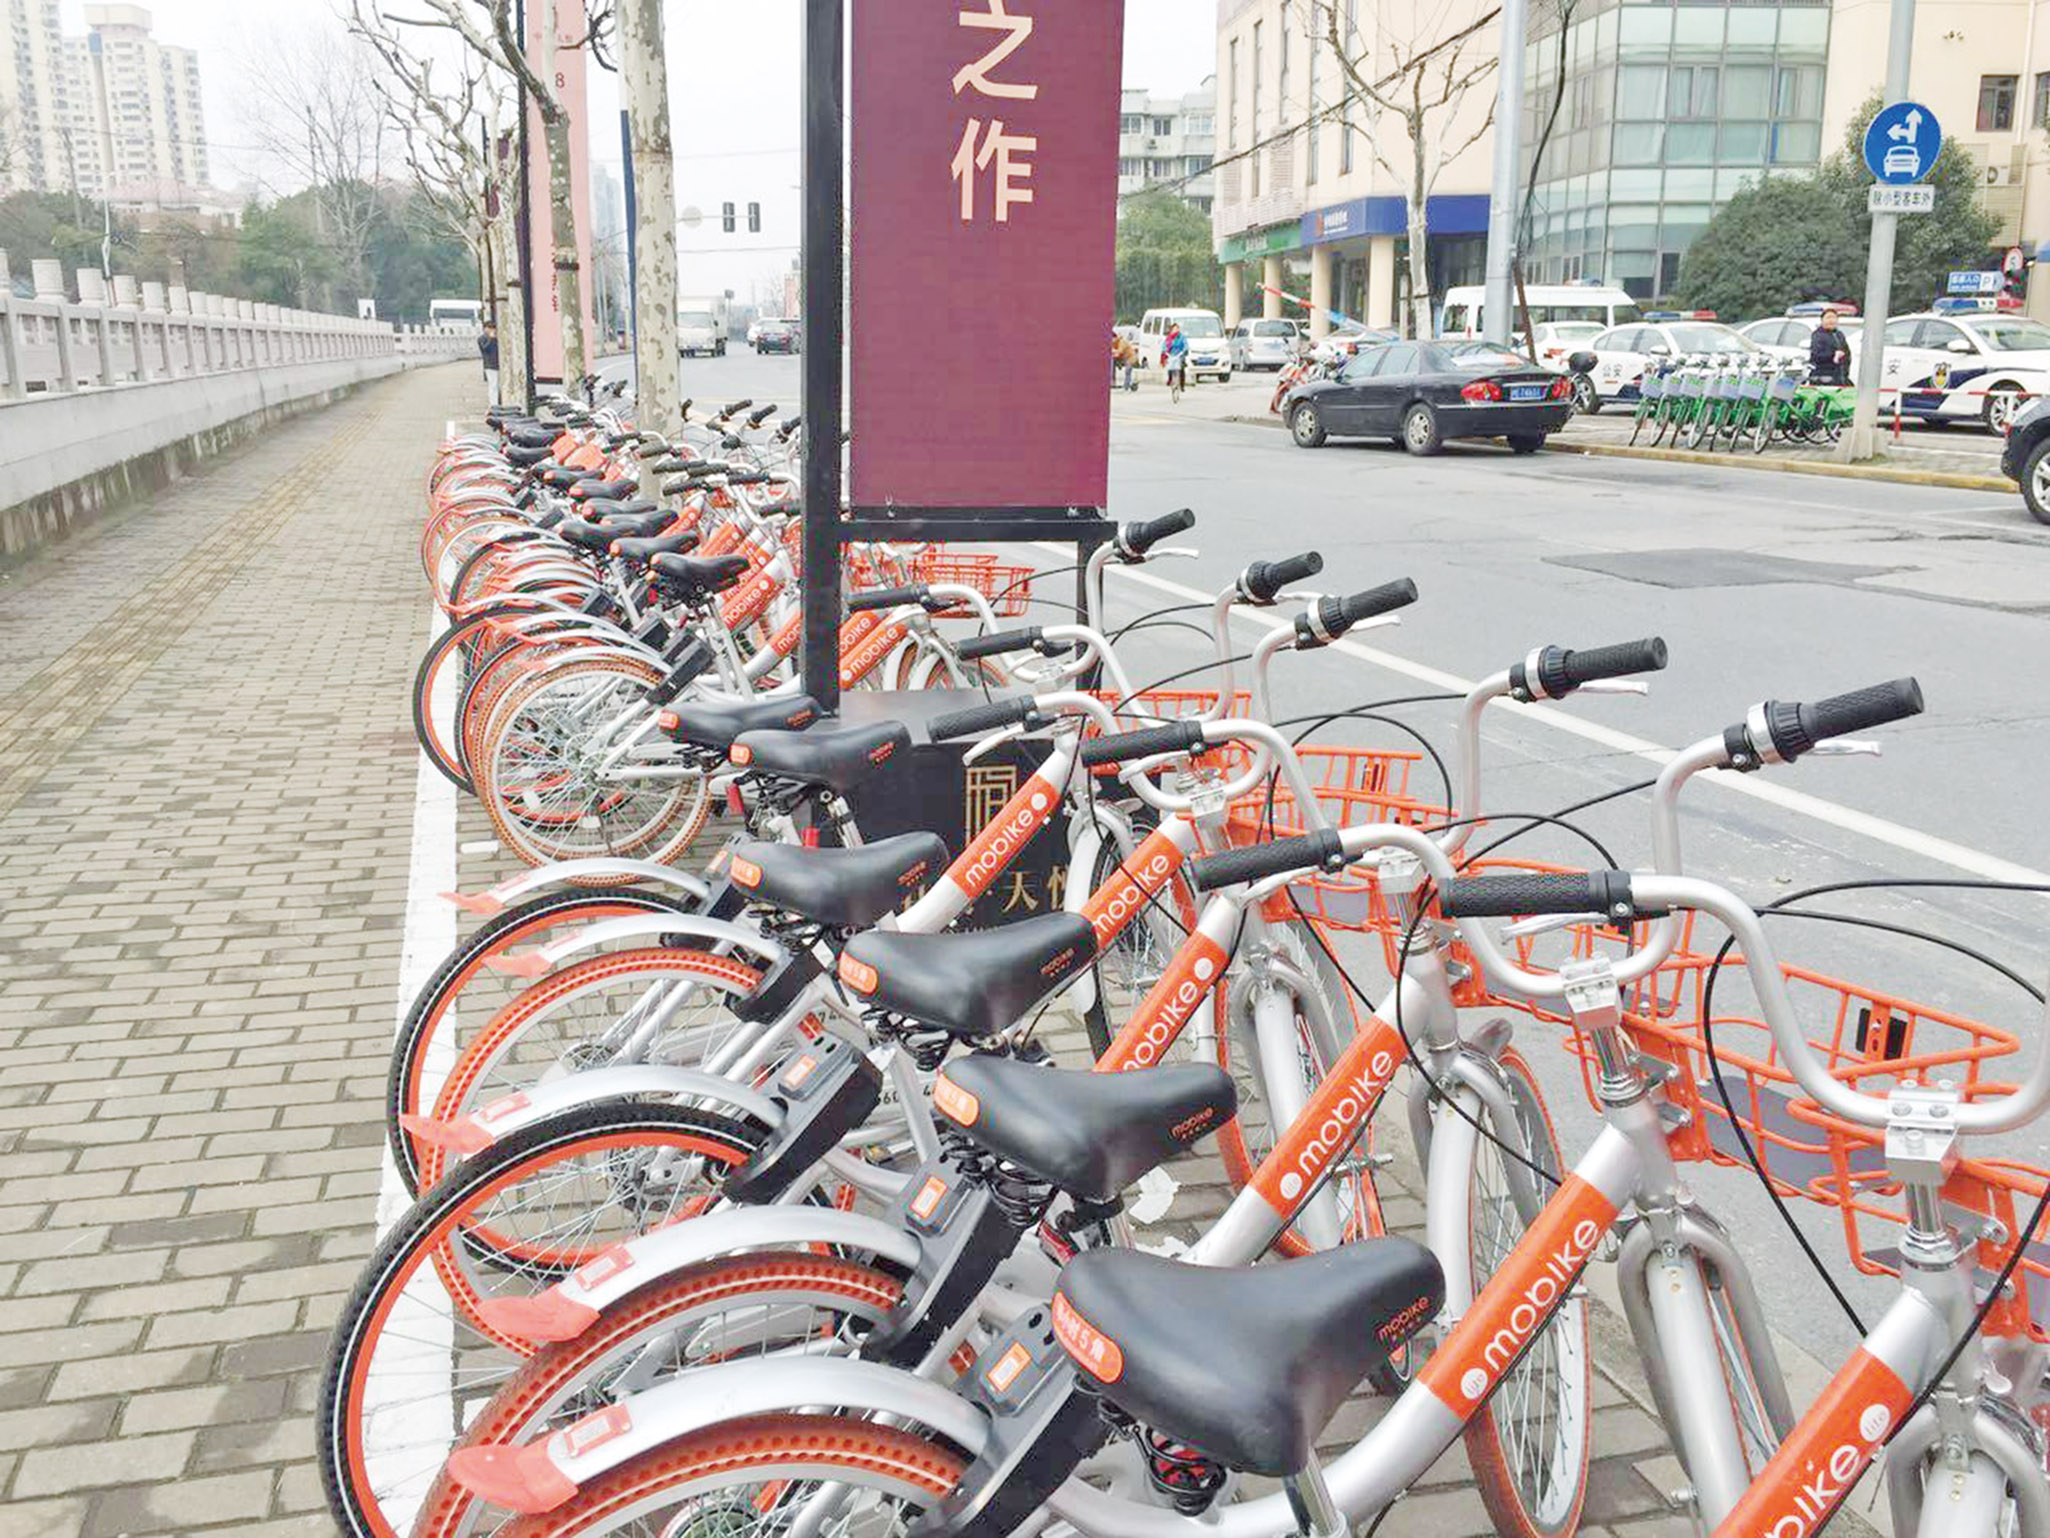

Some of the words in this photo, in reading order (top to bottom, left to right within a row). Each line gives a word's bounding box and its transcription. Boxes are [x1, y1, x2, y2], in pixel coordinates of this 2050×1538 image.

[951, 0, 1038, 222] 之作
[839, 616, 871, 650] obike
[849, 627, 899, 674] mobike
[965, 809, 1024, 887] mobike
[1093, 855, 1169, 938] mobike
[1299, 1051, 1393, 1176] mobike
[1378, 1297, 1430, 1341] mobike
[1484, 1220, 1599, 1371] mobike
[1764, 1444, 1860, 1538] bike
